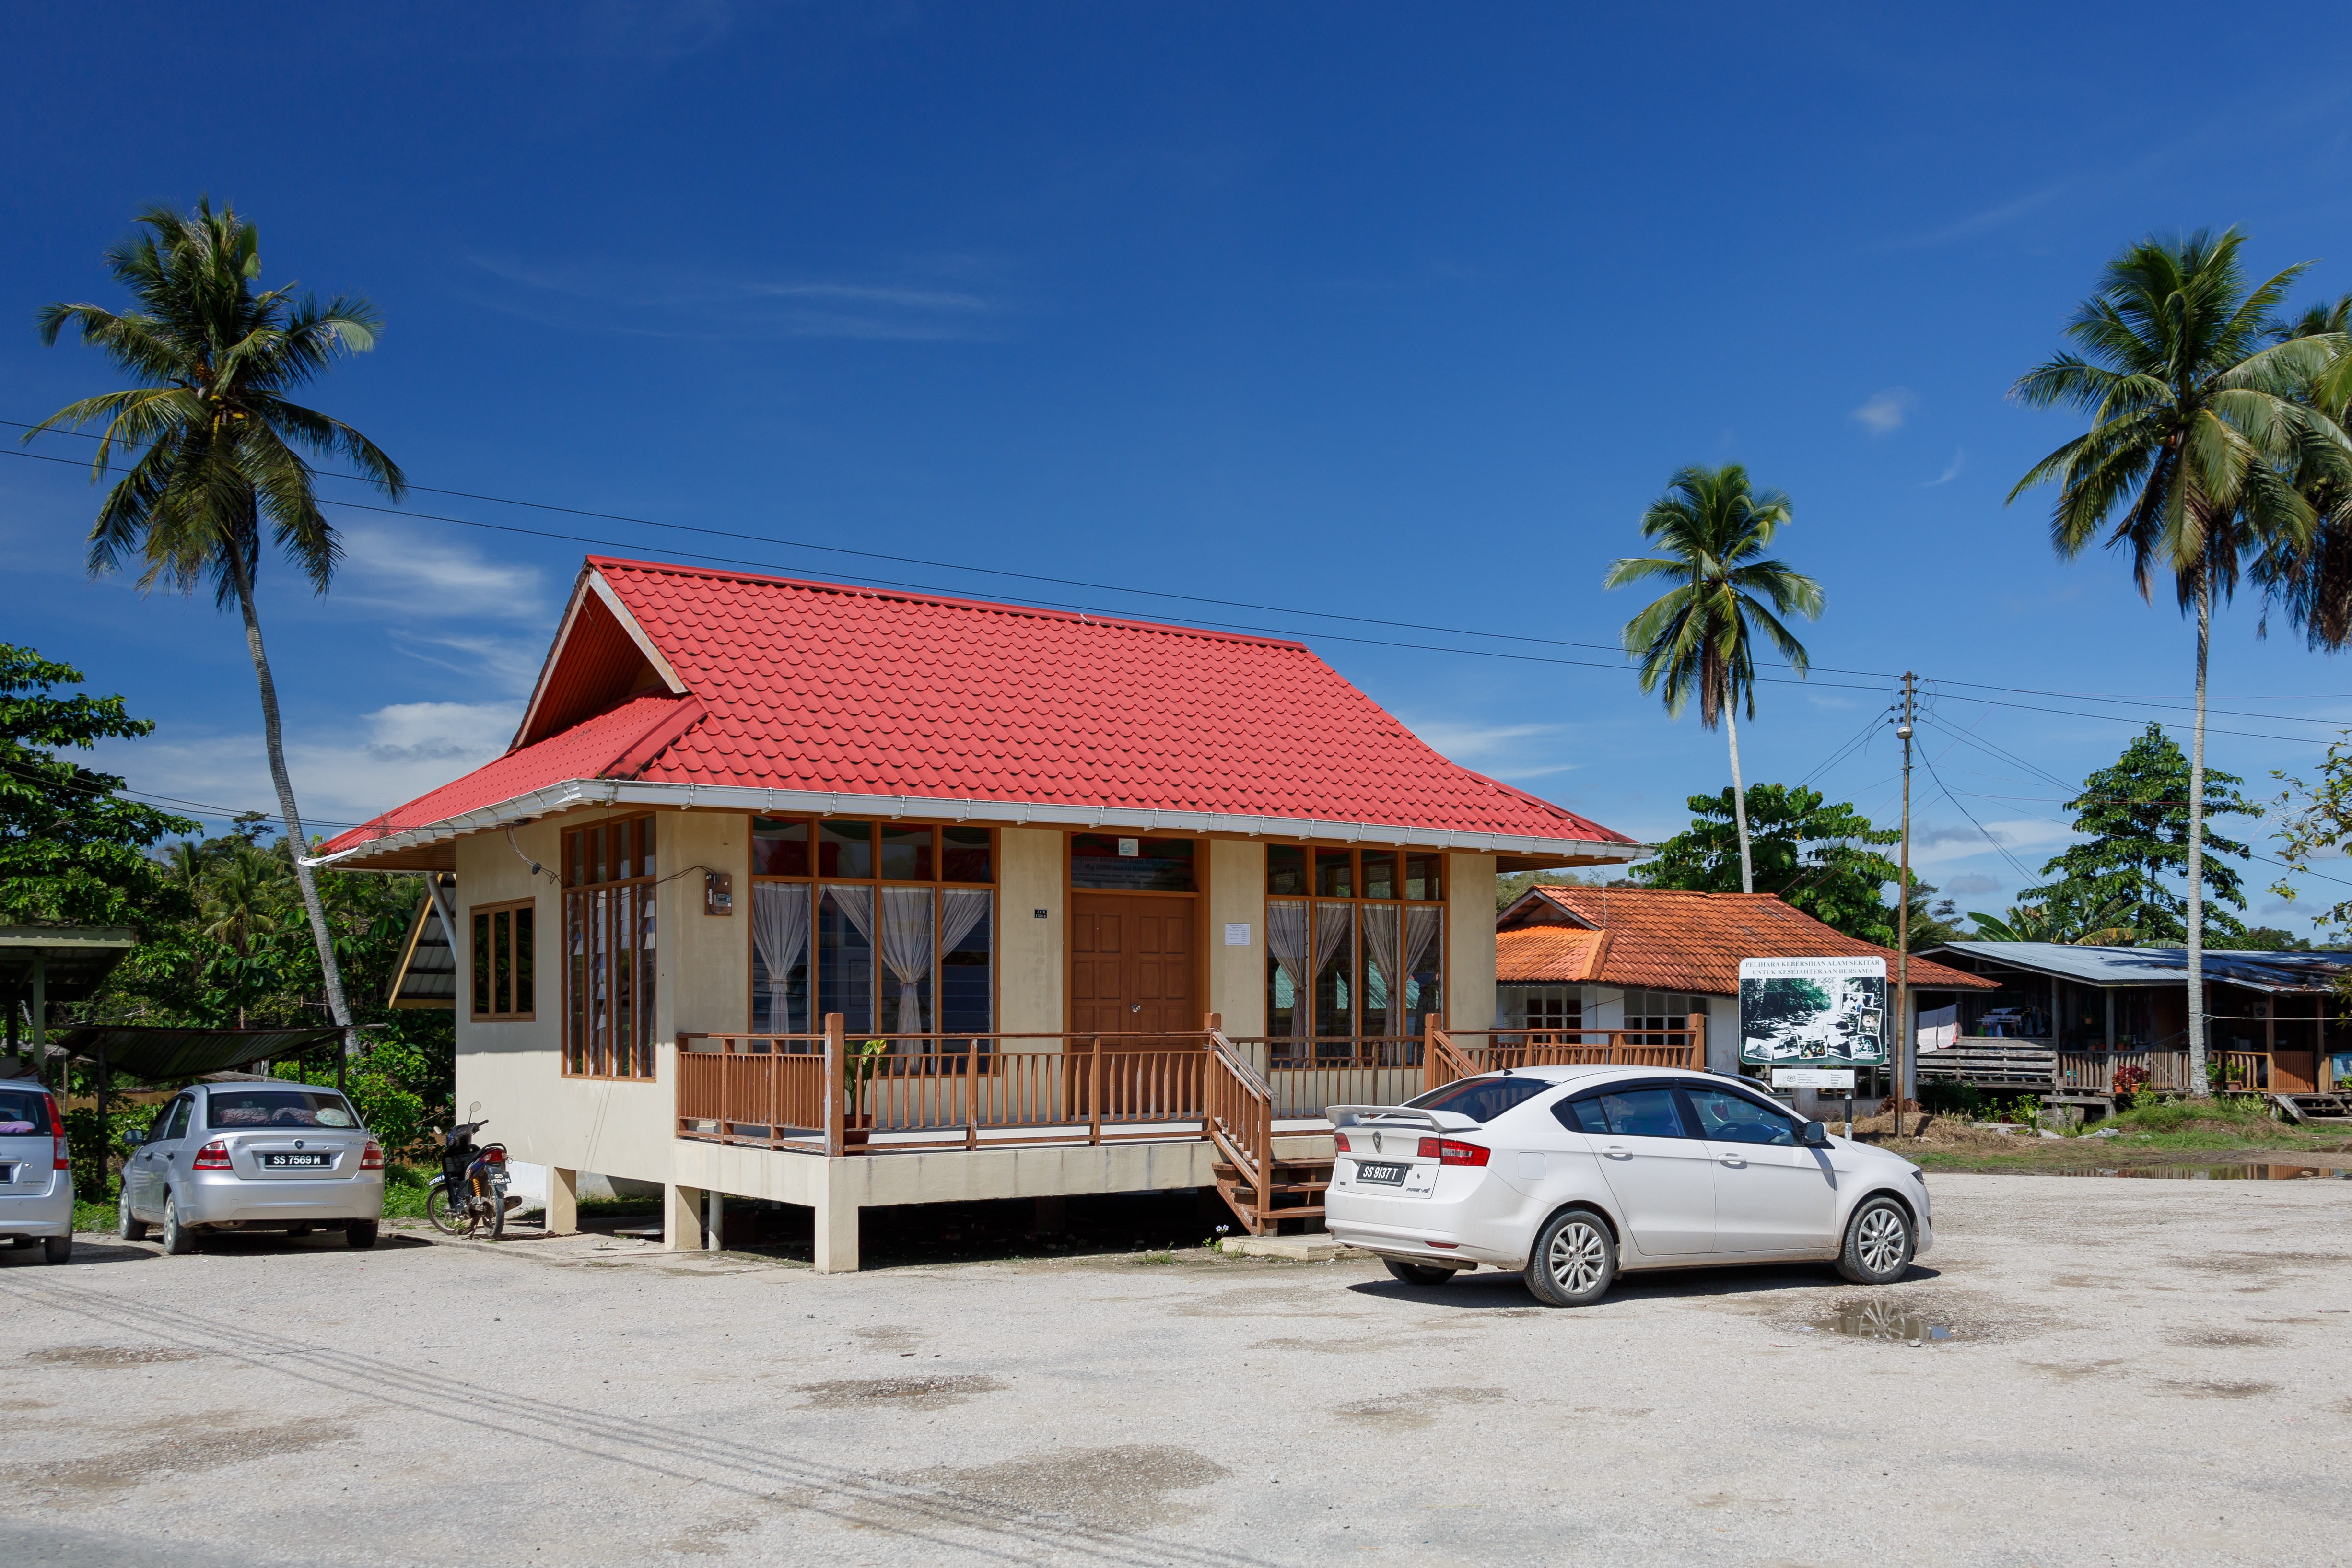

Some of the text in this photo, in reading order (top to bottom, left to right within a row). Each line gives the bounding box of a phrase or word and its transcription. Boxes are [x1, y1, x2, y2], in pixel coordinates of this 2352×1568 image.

[273, 1155, 320, 1164] SS 7569 M
[1363, 1166, 1399, 1180] SS 9137 T
